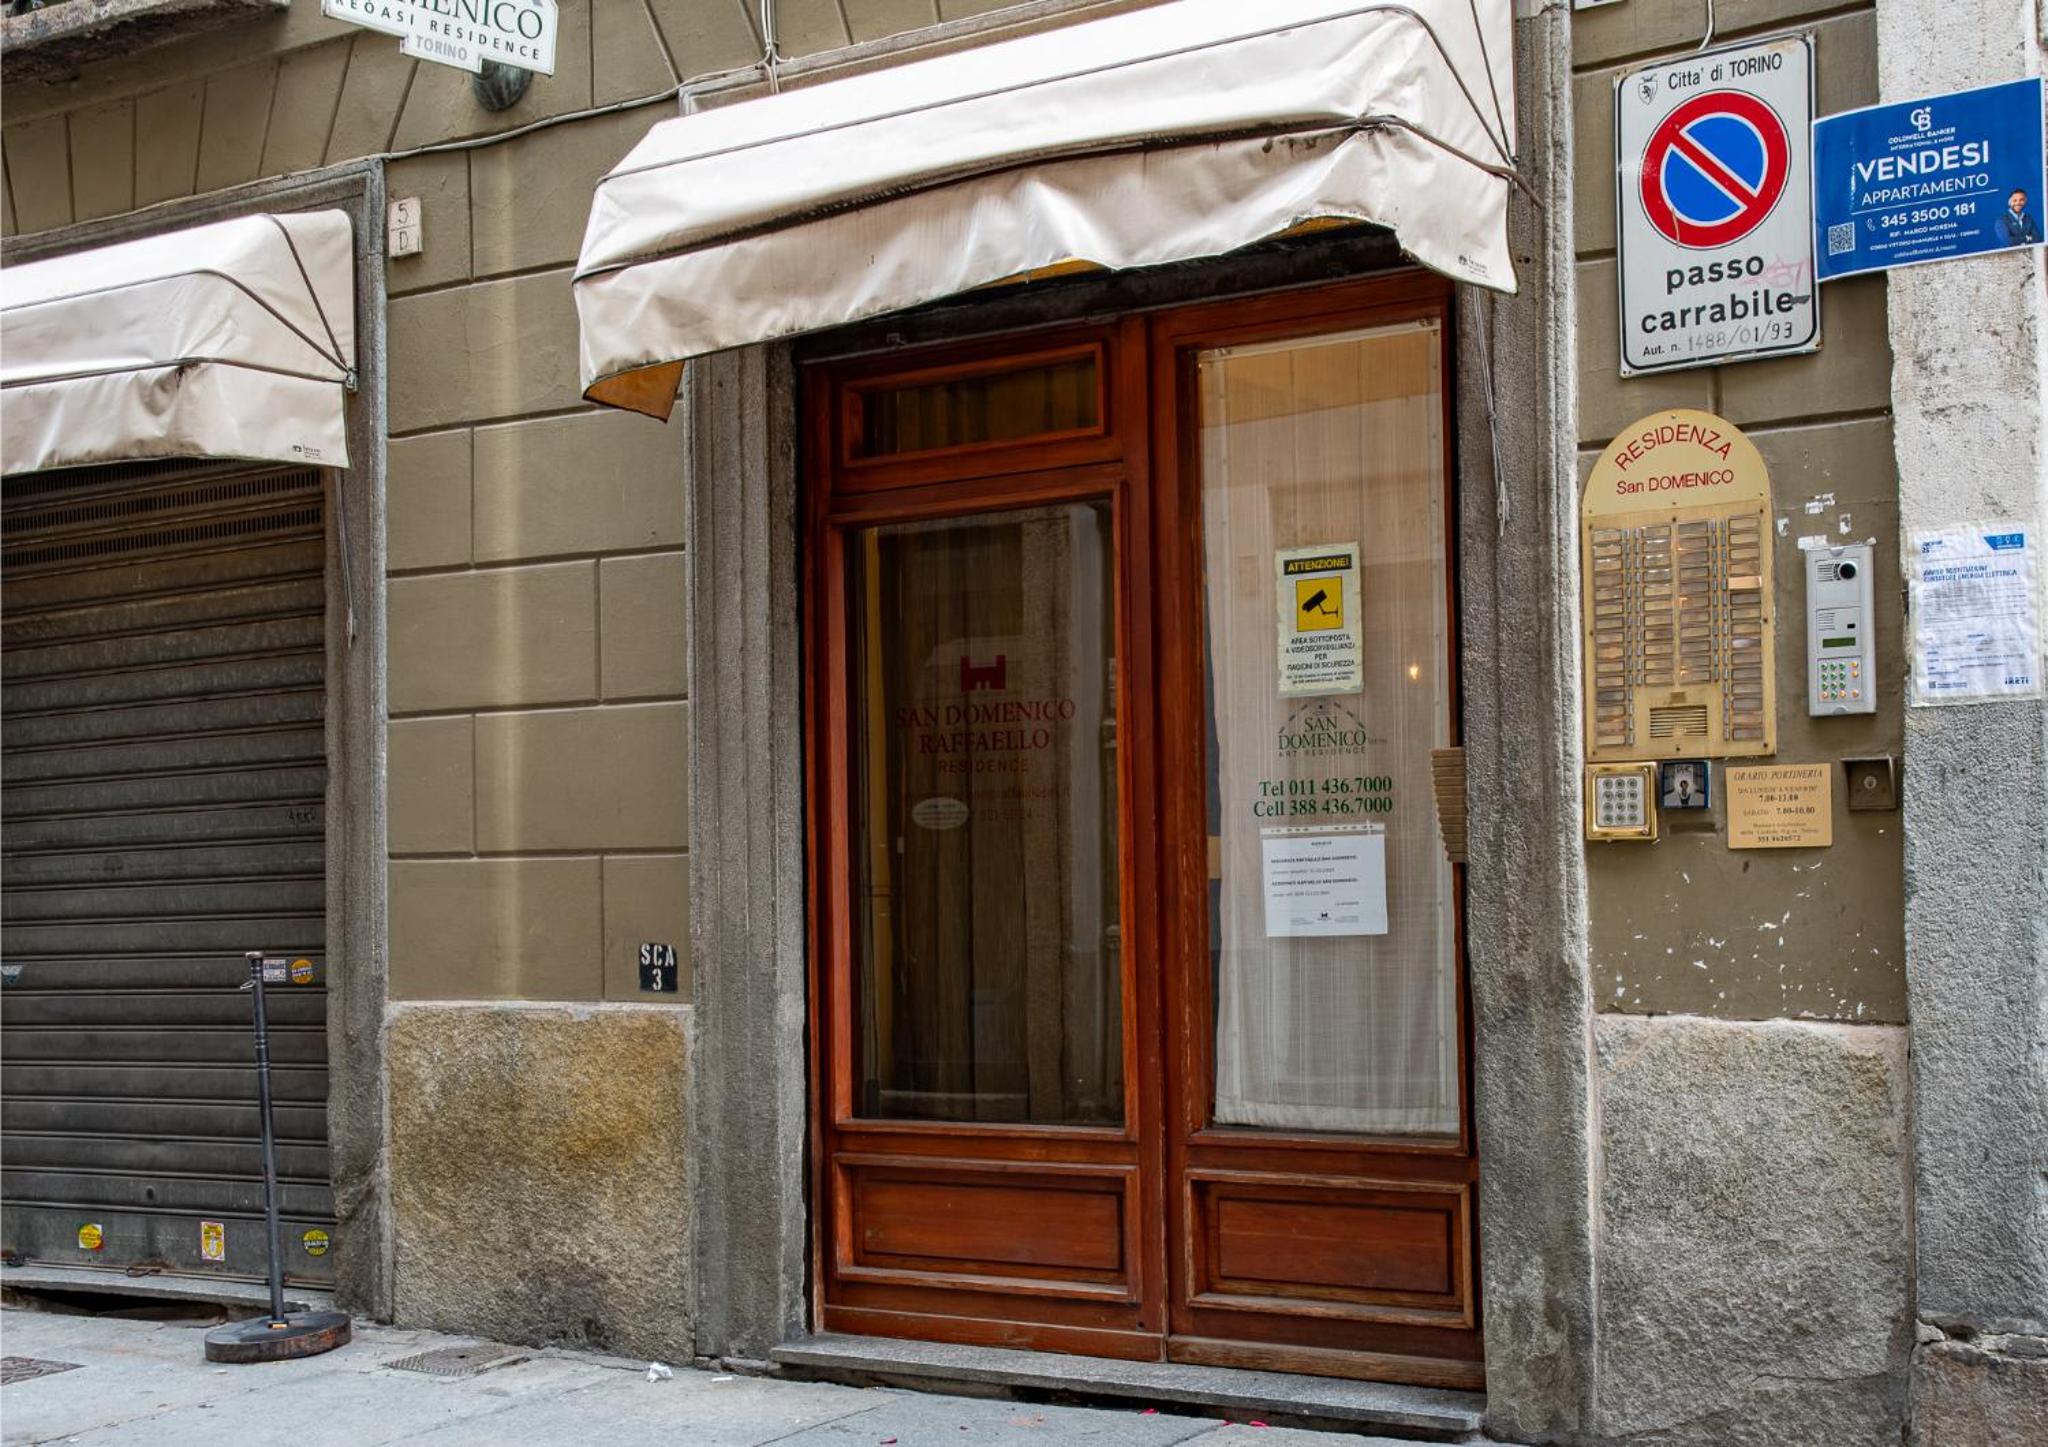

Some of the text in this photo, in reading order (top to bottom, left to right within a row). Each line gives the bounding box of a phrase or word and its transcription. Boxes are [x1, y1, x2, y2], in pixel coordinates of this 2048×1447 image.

[416, 35, 468, 61] TORINO
[430, 20, 540, 60] RESIDENCE
[1711, 65, 1723, 82] di
[1730, 52, 1782, 79] TORINO
[1857, 141, 1989, 182] VENDESI
[1862, 173, 1989, 206] APPARTAMENTO
[398, 202, 409, 225] 5
[1881, 202, 1976, 228] 345 3500 181
[1666, 255, 1764, 295] passo
[1641, 289, 1795, 334] carrabile
[1643, 344, 1665, 357] Aut.
[1670, 344, 1681, 353] n.
[1615, 424, 1732, 471] RESIDENZA
[1616, 469, 1734, 495] San DOMENICO
[1288, 557, 1349, 572] ATTENZIONE!
[896, 698, 1076, 729] SAN DOMENICO
[1304, 716, 1338, 732] SAN
[920, 728, 1050, 754] RAFFAELLO
[1279, 731, 1366, 750] DOMENICO
[938, 758, 1029, 775] RESIDENCE
[1259, 776, 1392, 797] Tel 011 436.7000
[1254, 797, 1393, 817] Cell 388 436.7000
[640, 943, 675, 967] SCA
[652, 967, 662, 991] 3
